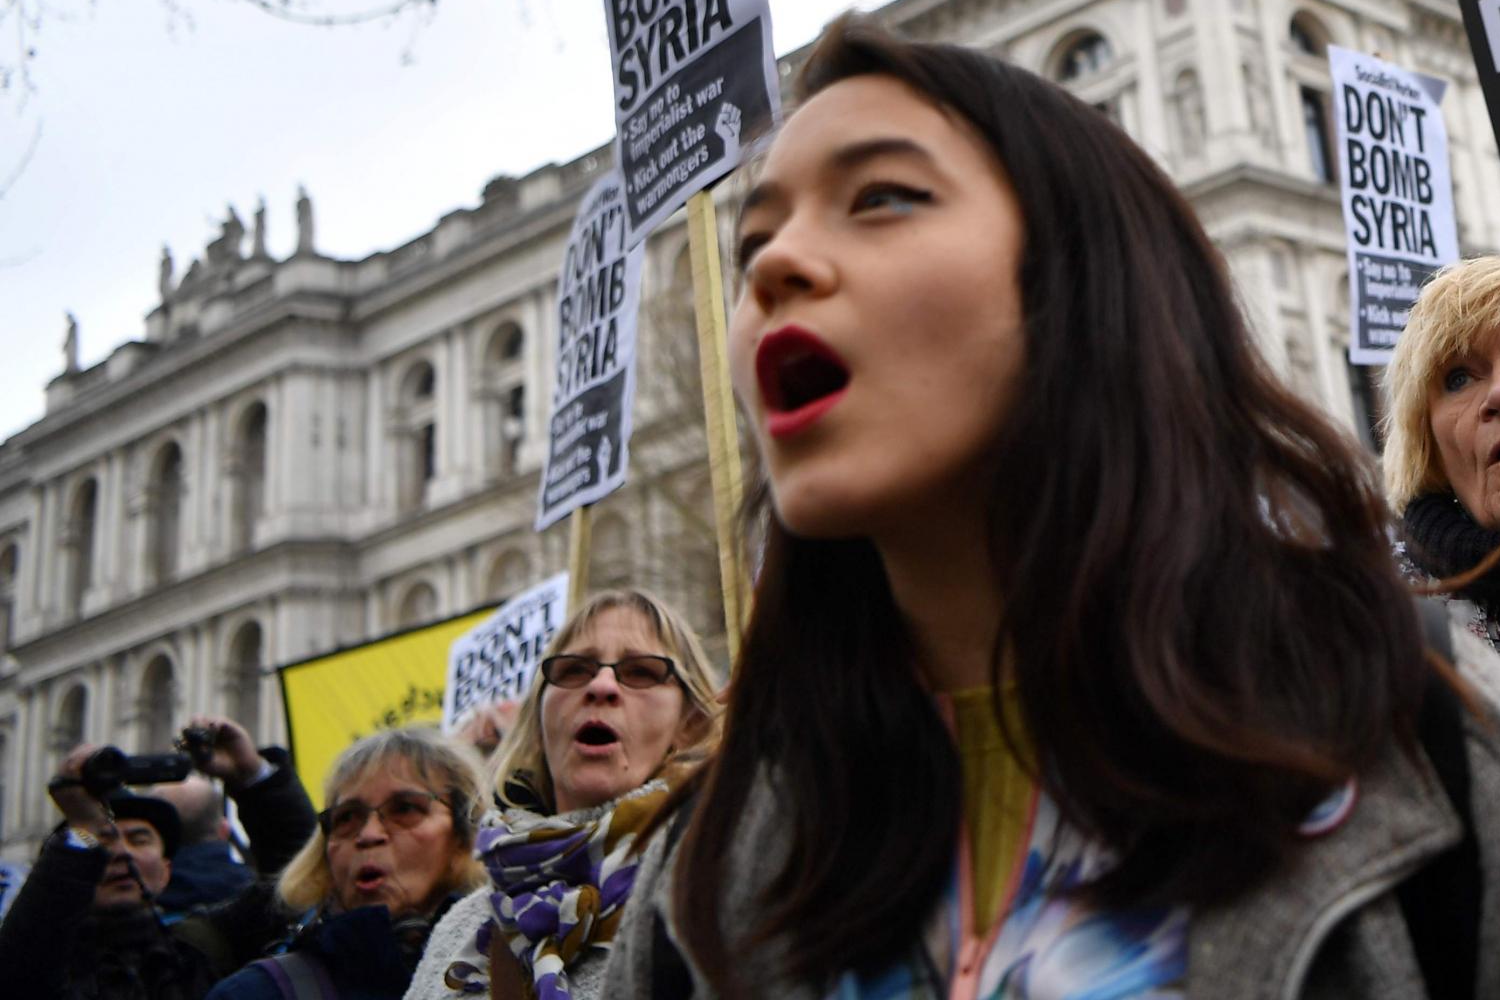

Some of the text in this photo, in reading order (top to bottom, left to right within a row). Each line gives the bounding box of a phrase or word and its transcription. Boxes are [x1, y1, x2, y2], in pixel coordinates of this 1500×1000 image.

[666, 83, 680, 104] to
[696, 76, 724, 107] war
[680, 122, 706, 150] the
[1343, 83, 1426, 153] DON'T
[1347, 137, 1434, 205] BOMB
[1351, 194, 1438, 258] SYRIA
